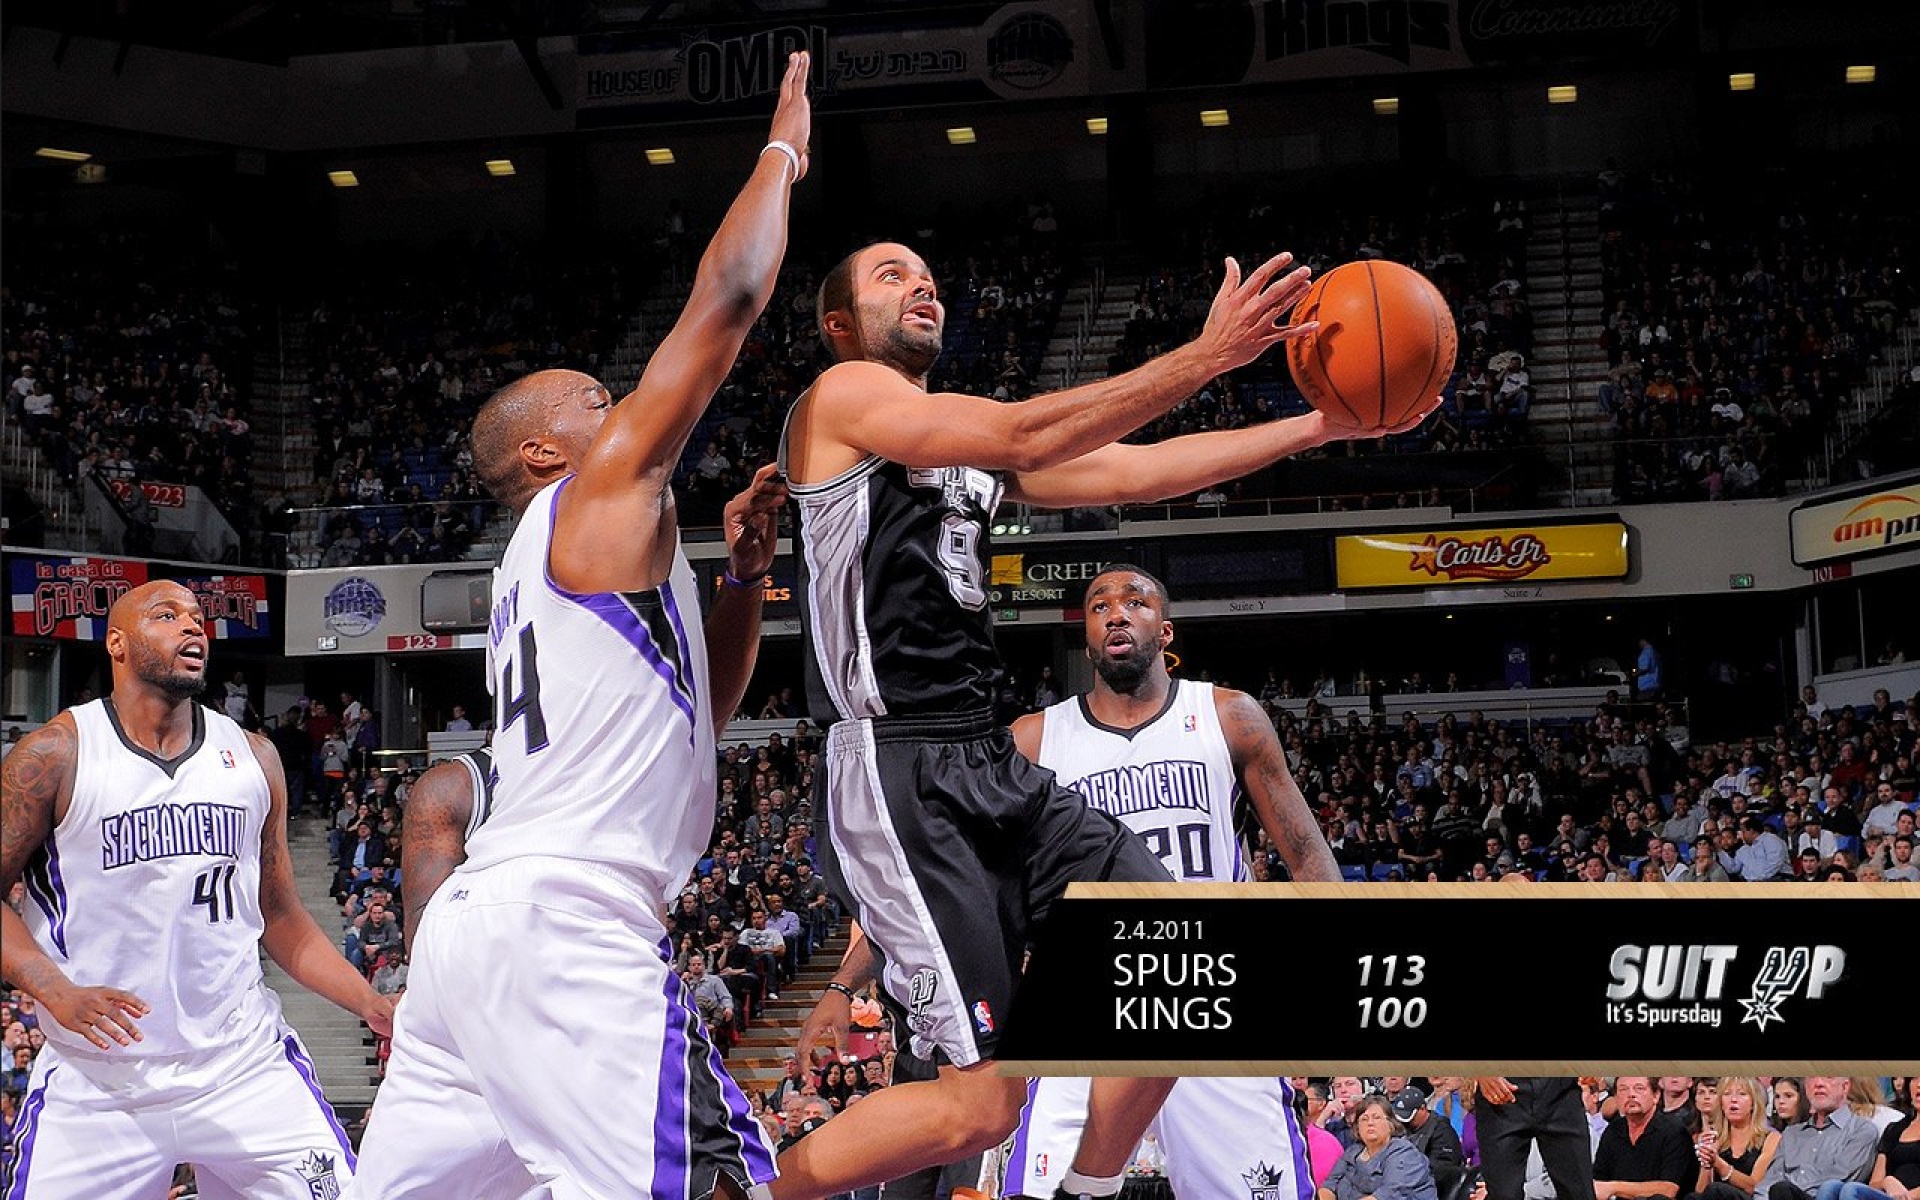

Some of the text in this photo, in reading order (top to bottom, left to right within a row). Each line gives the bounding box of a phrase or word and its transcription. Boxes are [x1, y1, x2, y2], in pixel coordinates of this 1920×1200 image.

[888, 48, 967, 76] הבית
[588, 69, 649, 97] HOUSE
[654, 67, 679, 91] OF
[149, 484, 184, 507] 223
[937, 511, 987, 612] 9
[1436, 538, 1506, 568] Carl's
[36, 560, 123, 579] la casa de
[1011, 587, 1067, 602] RESORT
[404, 634, 438, 649] 123
[102, 802, 247, 870] SACRAMENTO
[192, 864, 238, 925] 41
